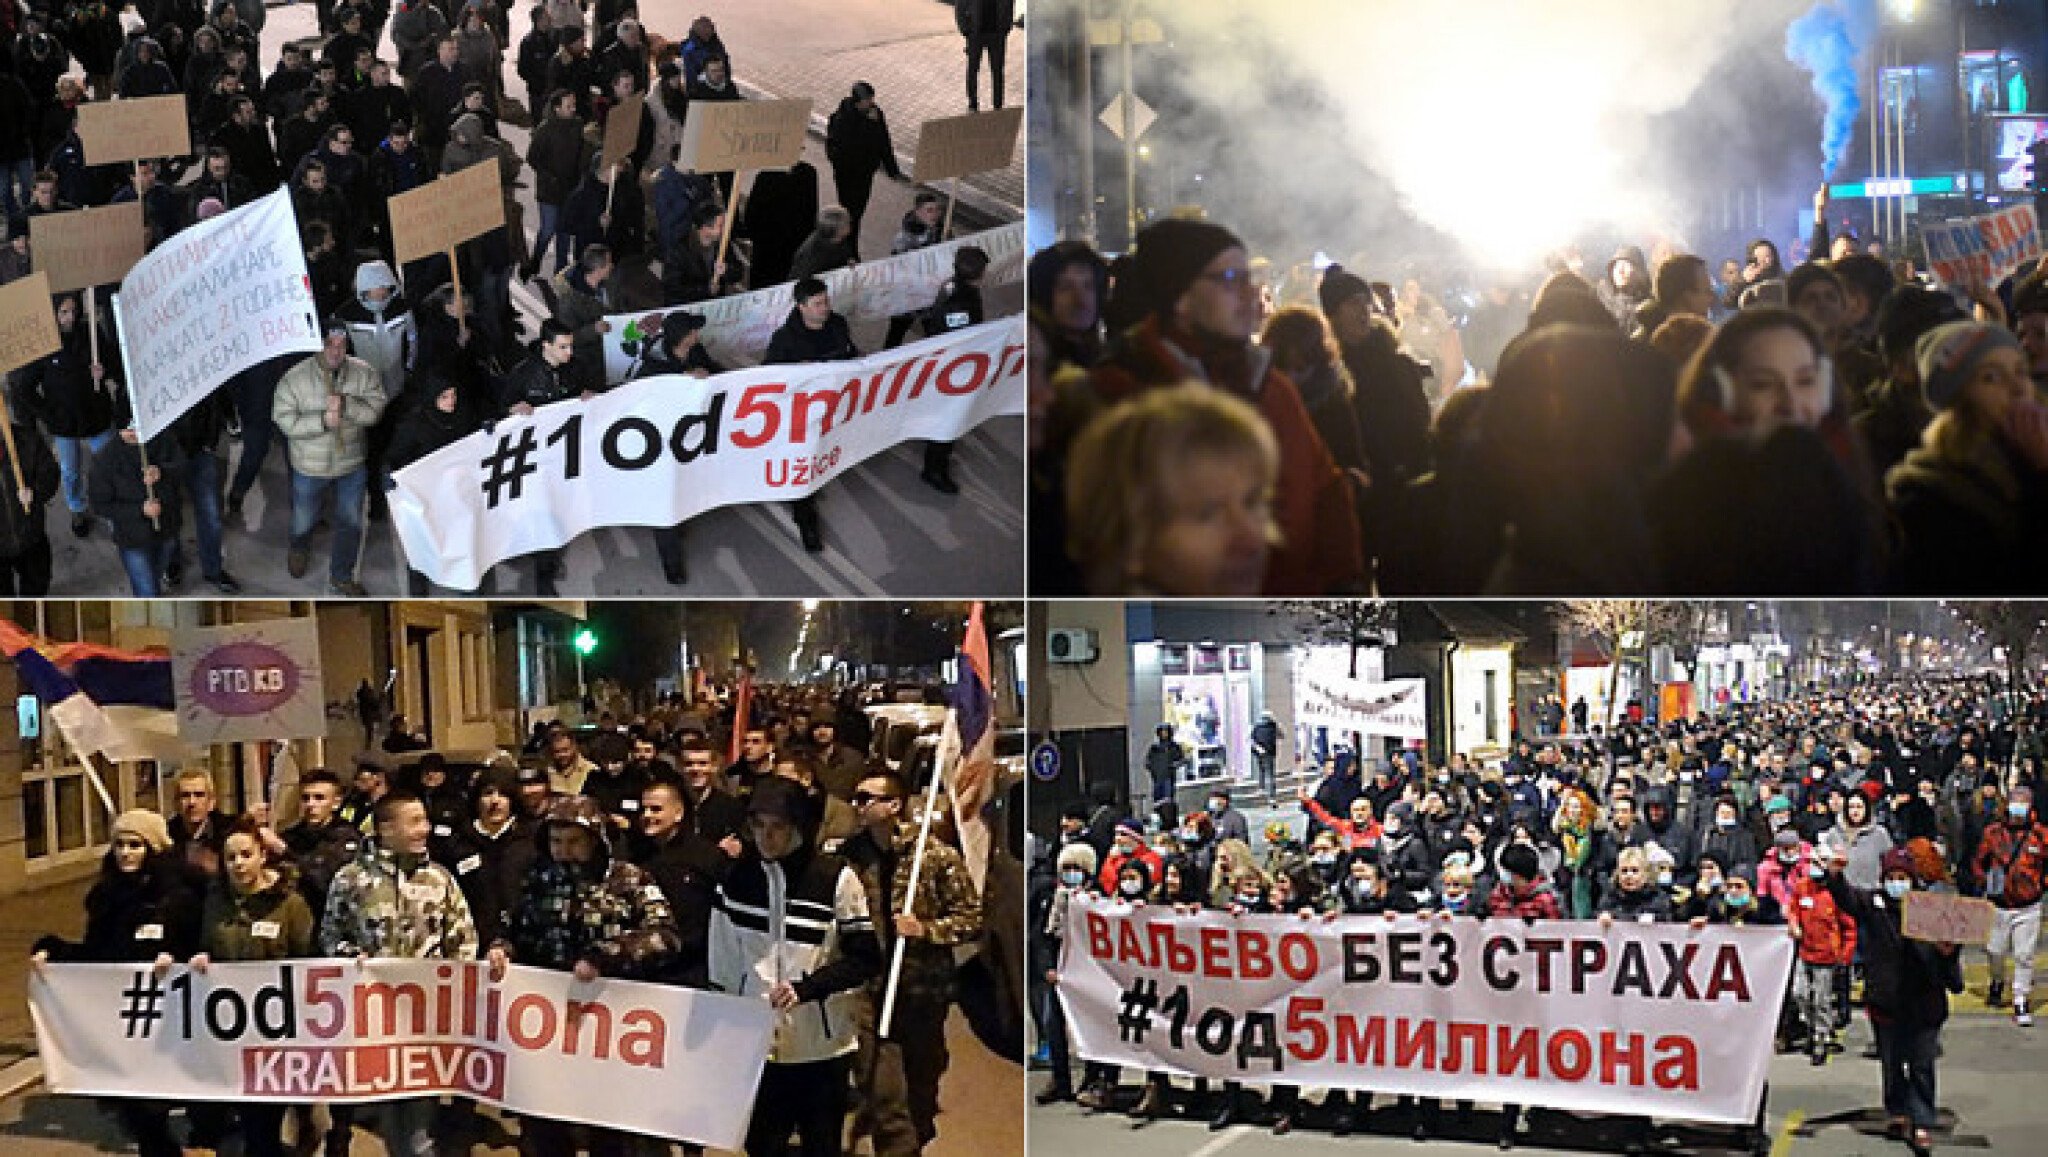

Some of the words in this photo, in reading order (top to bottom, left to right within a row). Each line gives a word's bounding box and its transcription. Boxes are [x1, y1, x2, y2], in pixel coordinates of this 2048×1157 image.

[763, 445, 843, 489] Užice
[1086, 910, 1319, 982] ВАЉЕВО
[1341, 932, 1459, 989] БЕЗ
[1483, 935, 1752, 1002] СТРАХА
[120, 966, 668, 1070] #1od5miliona
[1117, 976, 1699, 1092] #1од5милиона
[253, 1043, 494, 1093] KRALJEVO
